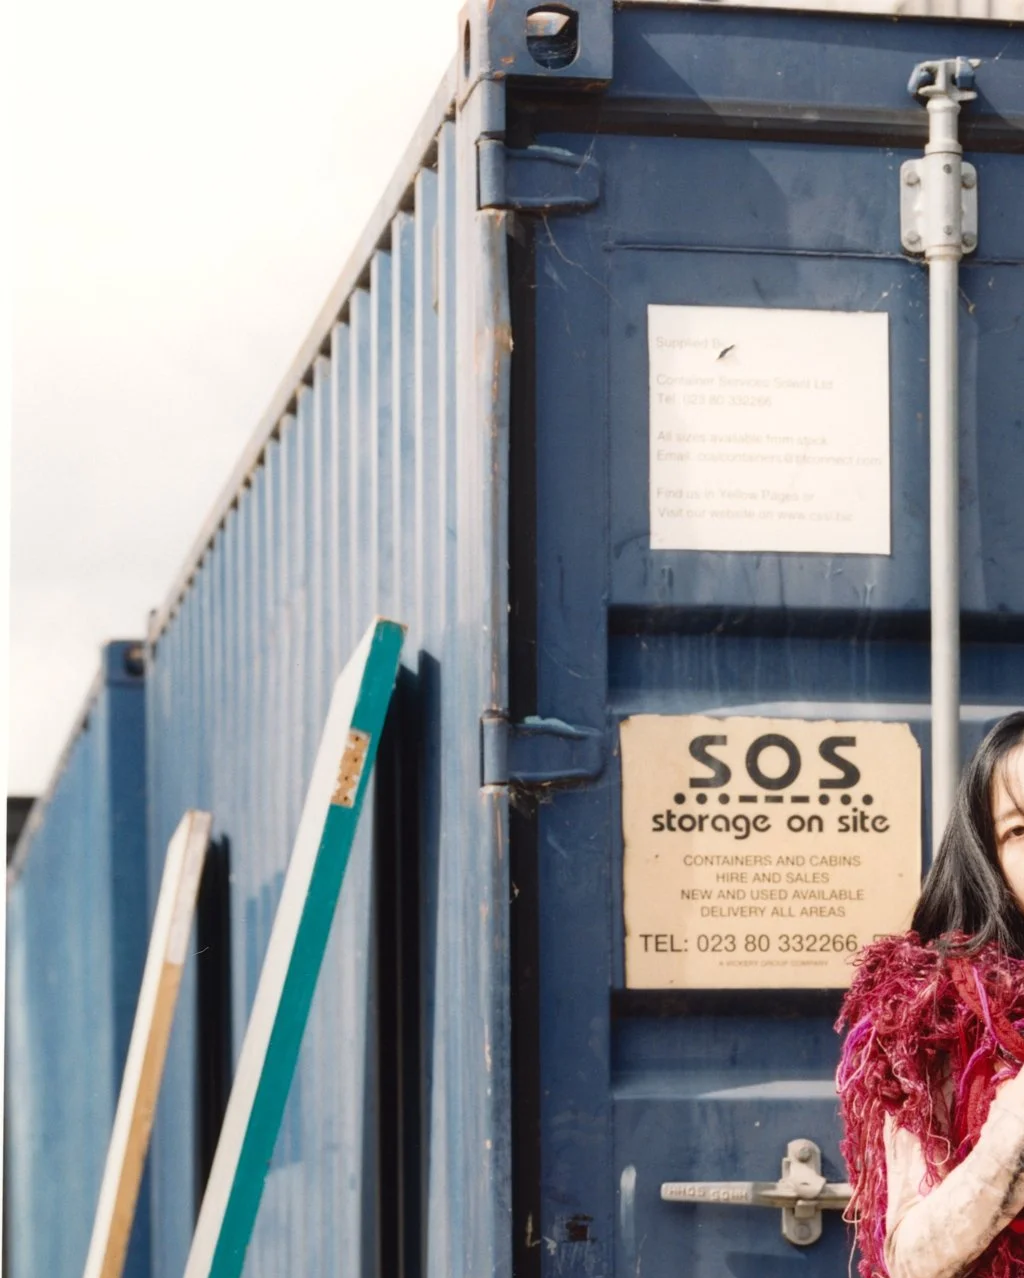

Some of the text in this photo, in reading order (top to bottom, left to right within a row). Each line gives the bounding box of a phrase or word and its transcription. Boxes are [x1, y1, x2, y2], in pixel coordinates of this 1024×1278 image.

[652, 808, 890, 839] storage on site
[683, 855, 862, 868] CONTAINERS AND CABINS
[716, 872, 830, 884] HIRE AND SALES
[681, 889, 865, 901] NEW AND USED AVAILABLE
[700, 906, 846, 918] DELIVERY ALL AREAS
[639, 934, 688, 952] TEL:
[696, 934, 737, 952] 023
[744, 934, 771, 952] 80
[778, 934, 858, 953] 332266
